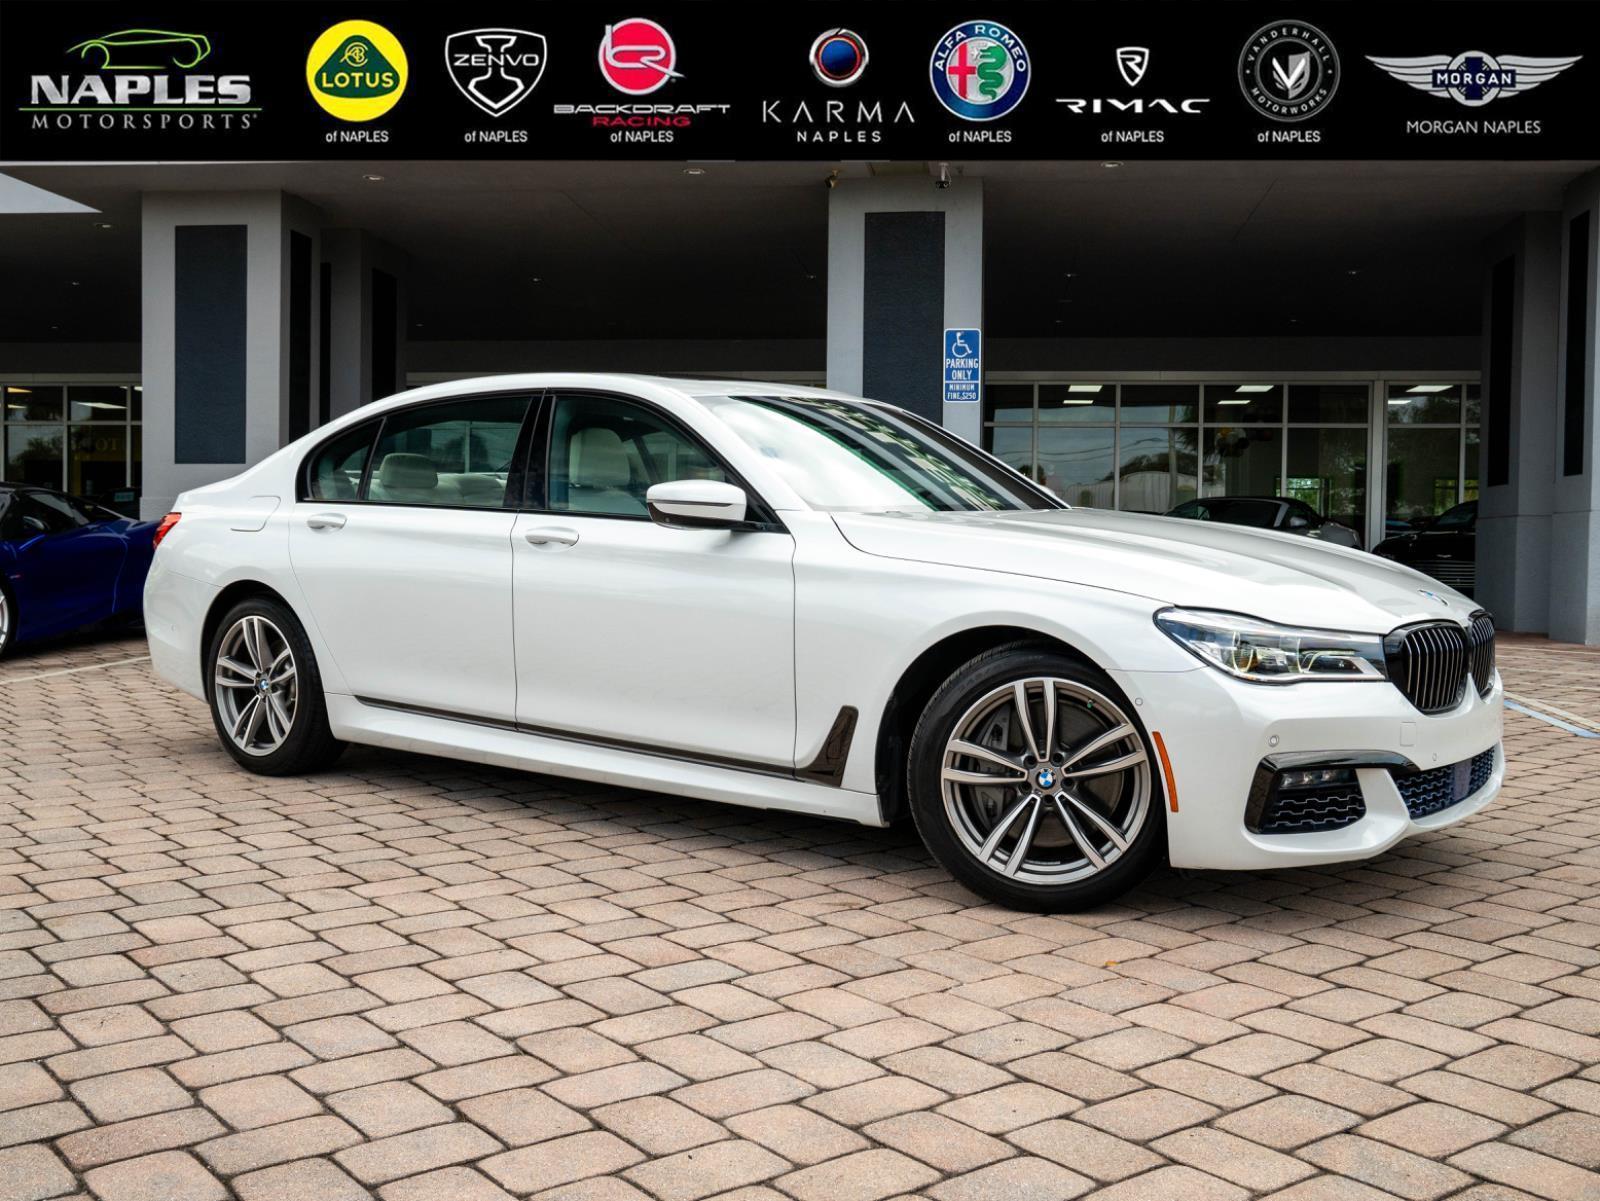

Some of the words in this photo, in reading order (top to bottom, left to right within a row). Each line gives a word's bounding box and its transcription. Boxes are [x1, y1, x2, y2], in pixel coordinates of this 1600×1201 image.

[946, 358, 978, 368] PARKING
[952, 370, 972, 380] ONLY
[949, 383, 975, 391] MINIMUM
